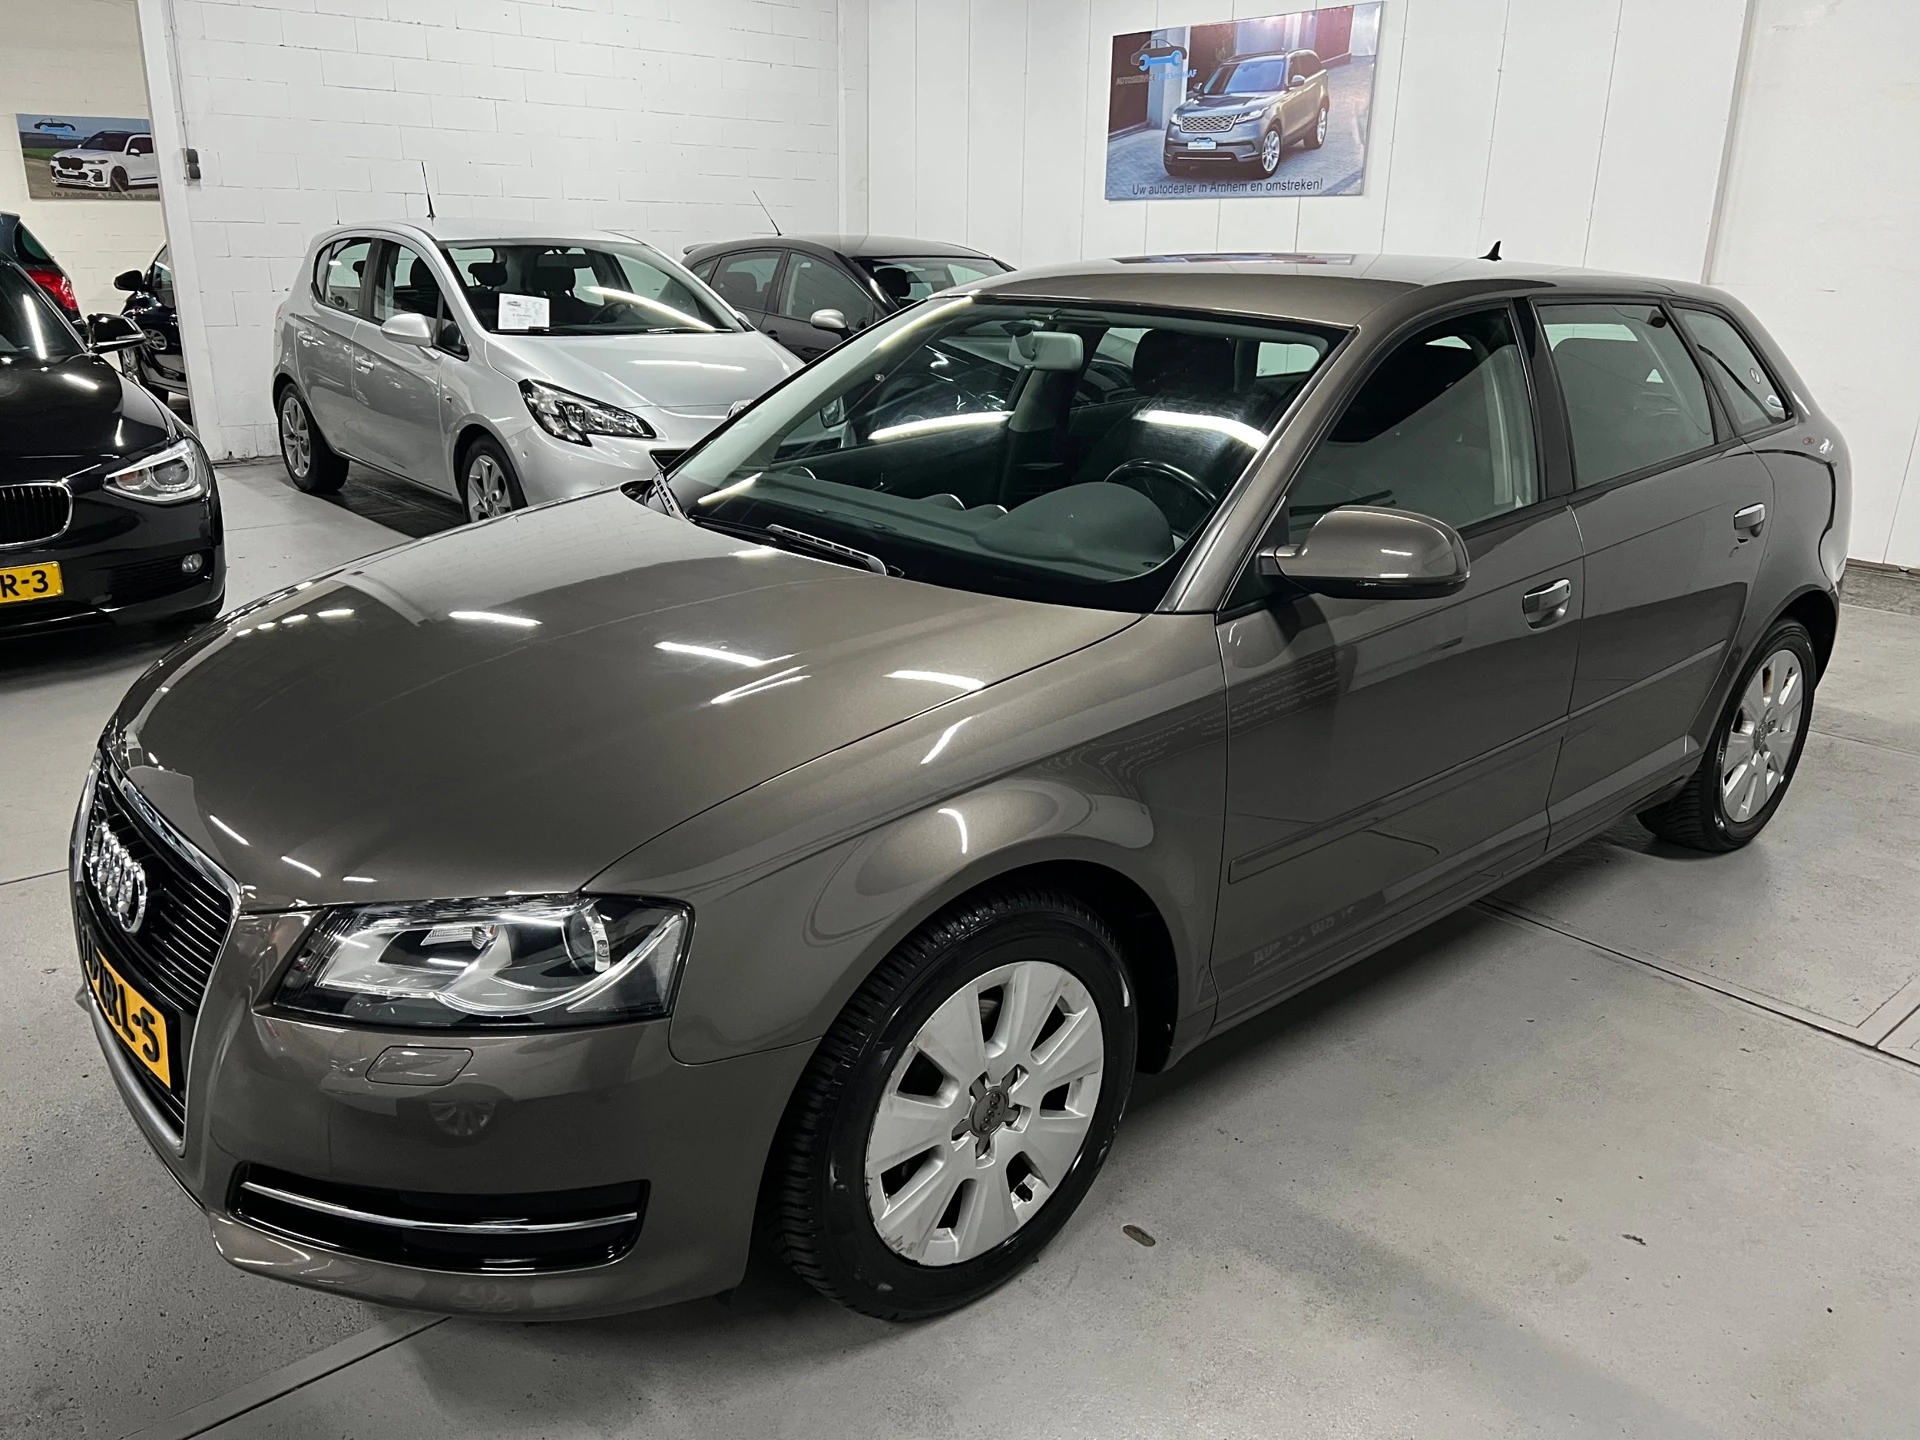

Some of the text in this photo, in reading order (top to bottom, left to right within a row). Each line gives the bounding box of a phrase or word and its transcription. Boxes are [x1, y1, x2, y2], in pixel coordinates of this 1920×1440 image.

[1132, 178, 1324, 195] Uw autodealer in Arnhem en omstreken!
[0, 569, 49, 598] R-3
